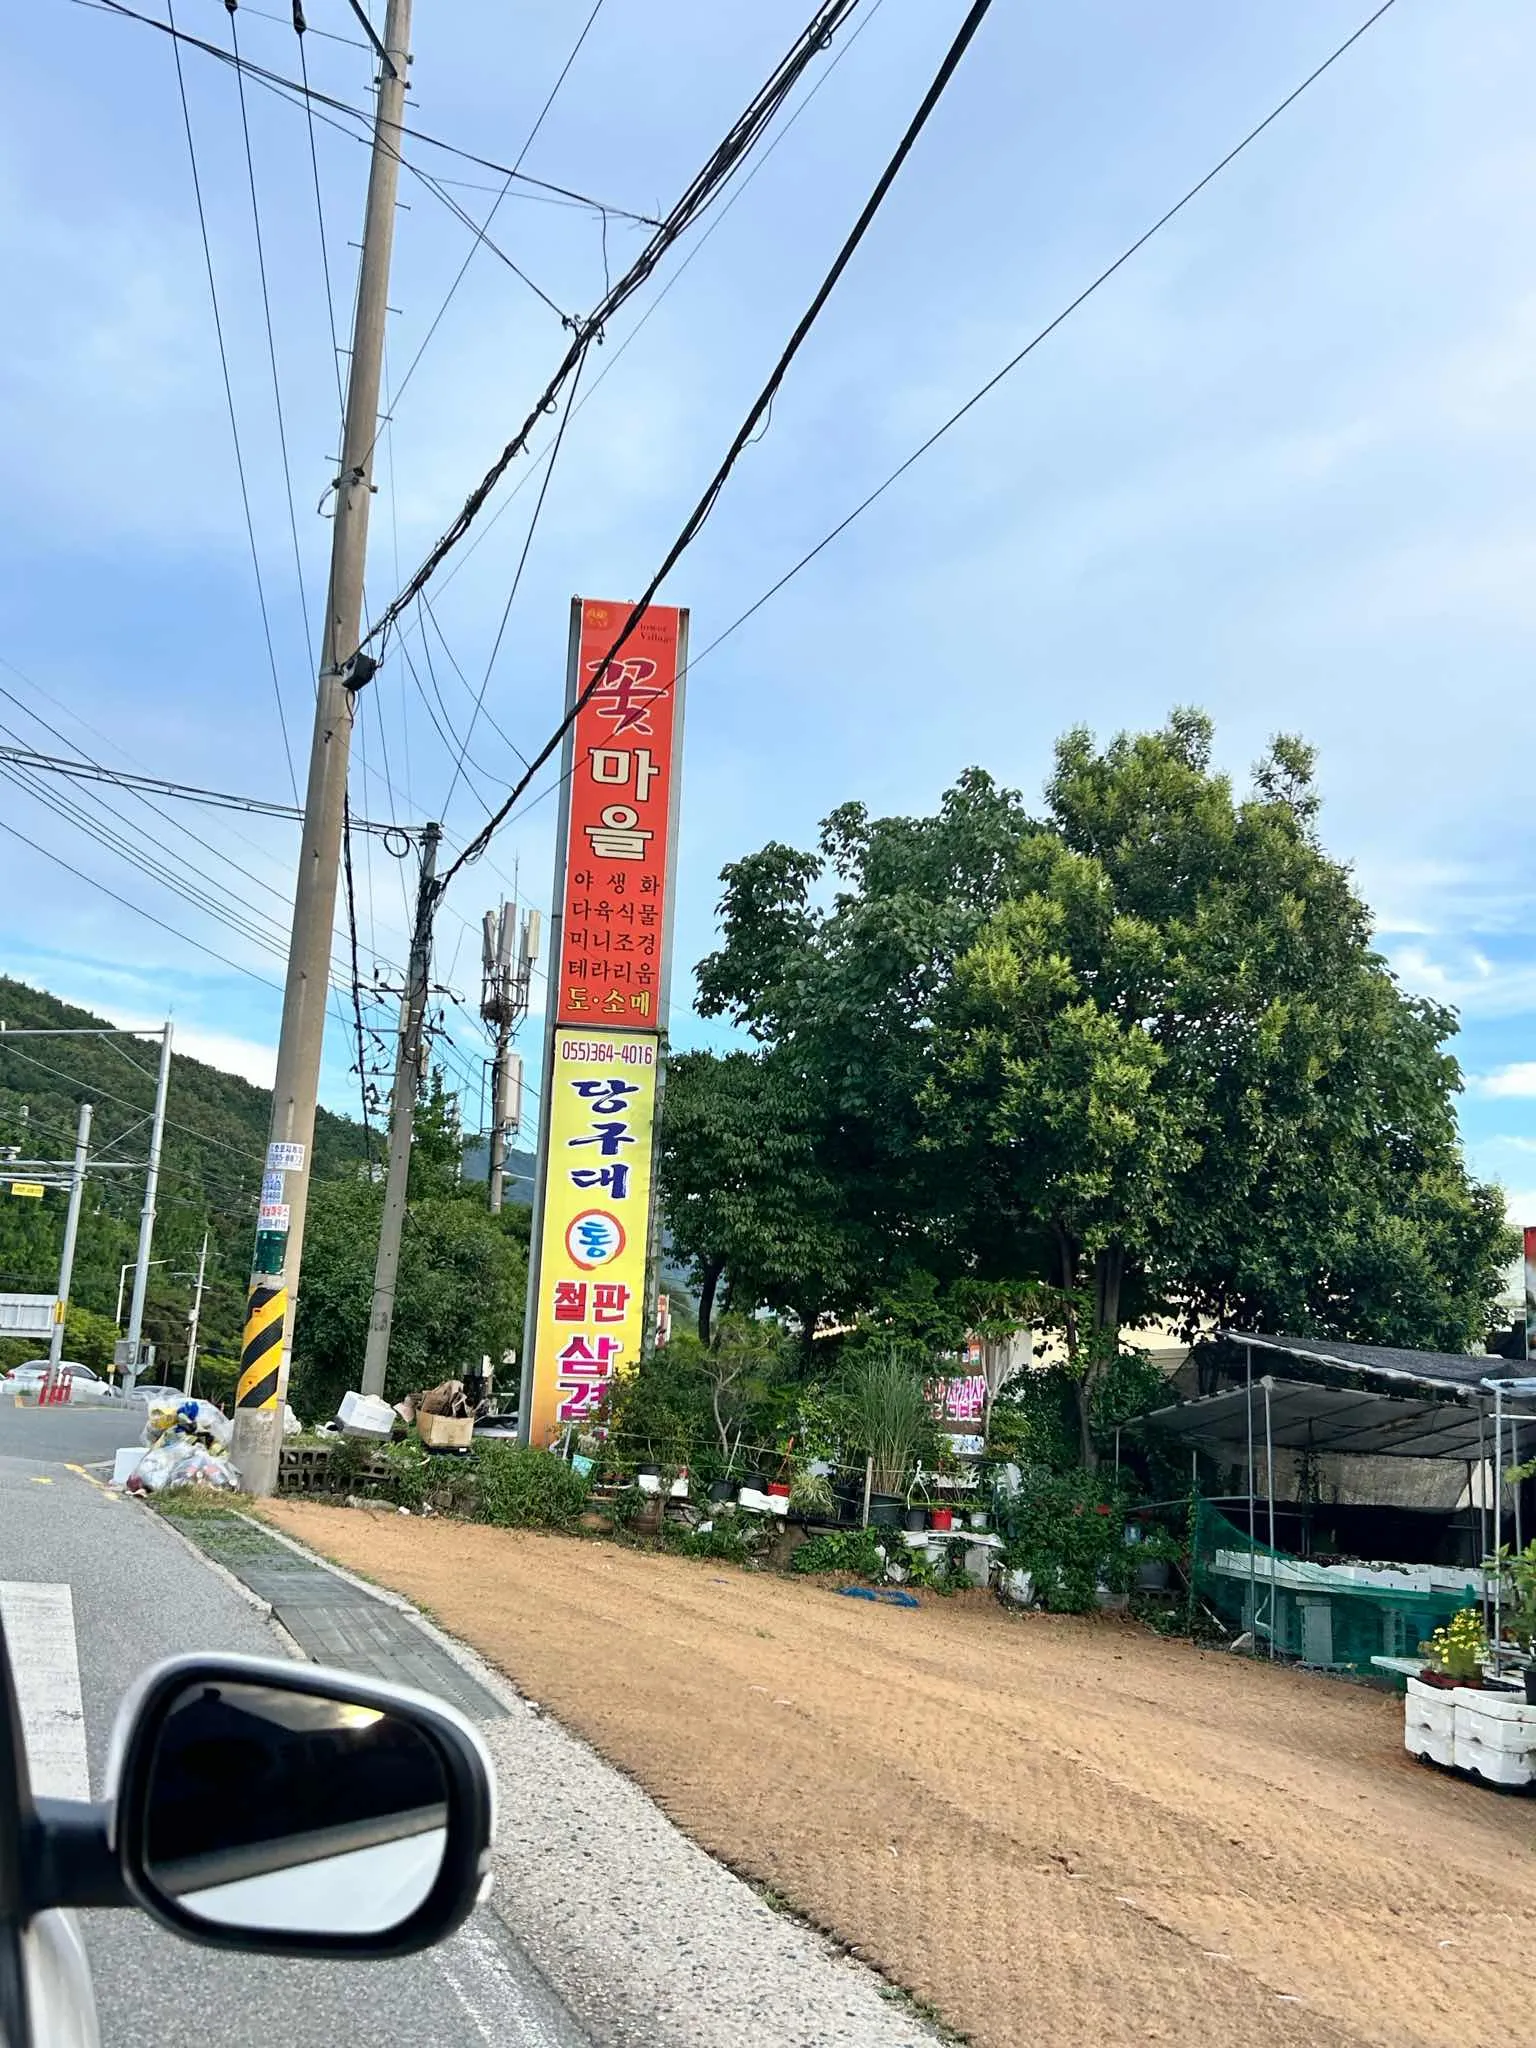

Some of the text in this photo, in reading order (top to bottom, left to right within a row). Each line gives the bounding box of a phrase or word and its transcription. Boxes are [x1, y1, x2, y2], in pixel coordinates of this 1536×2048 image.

[584, 657, 669, 861] 꽃마을
[572, 899, 659, 926] 다육식물
[568, 928, 655, 956] 미니조경
[568, 958, 656, 985] 테라리움
[562, 1040, 653, 1065] 055)364-4016
[554, 1281, 631, 1322] 철판
[559, 1336, 619, 1440] 삼겹
